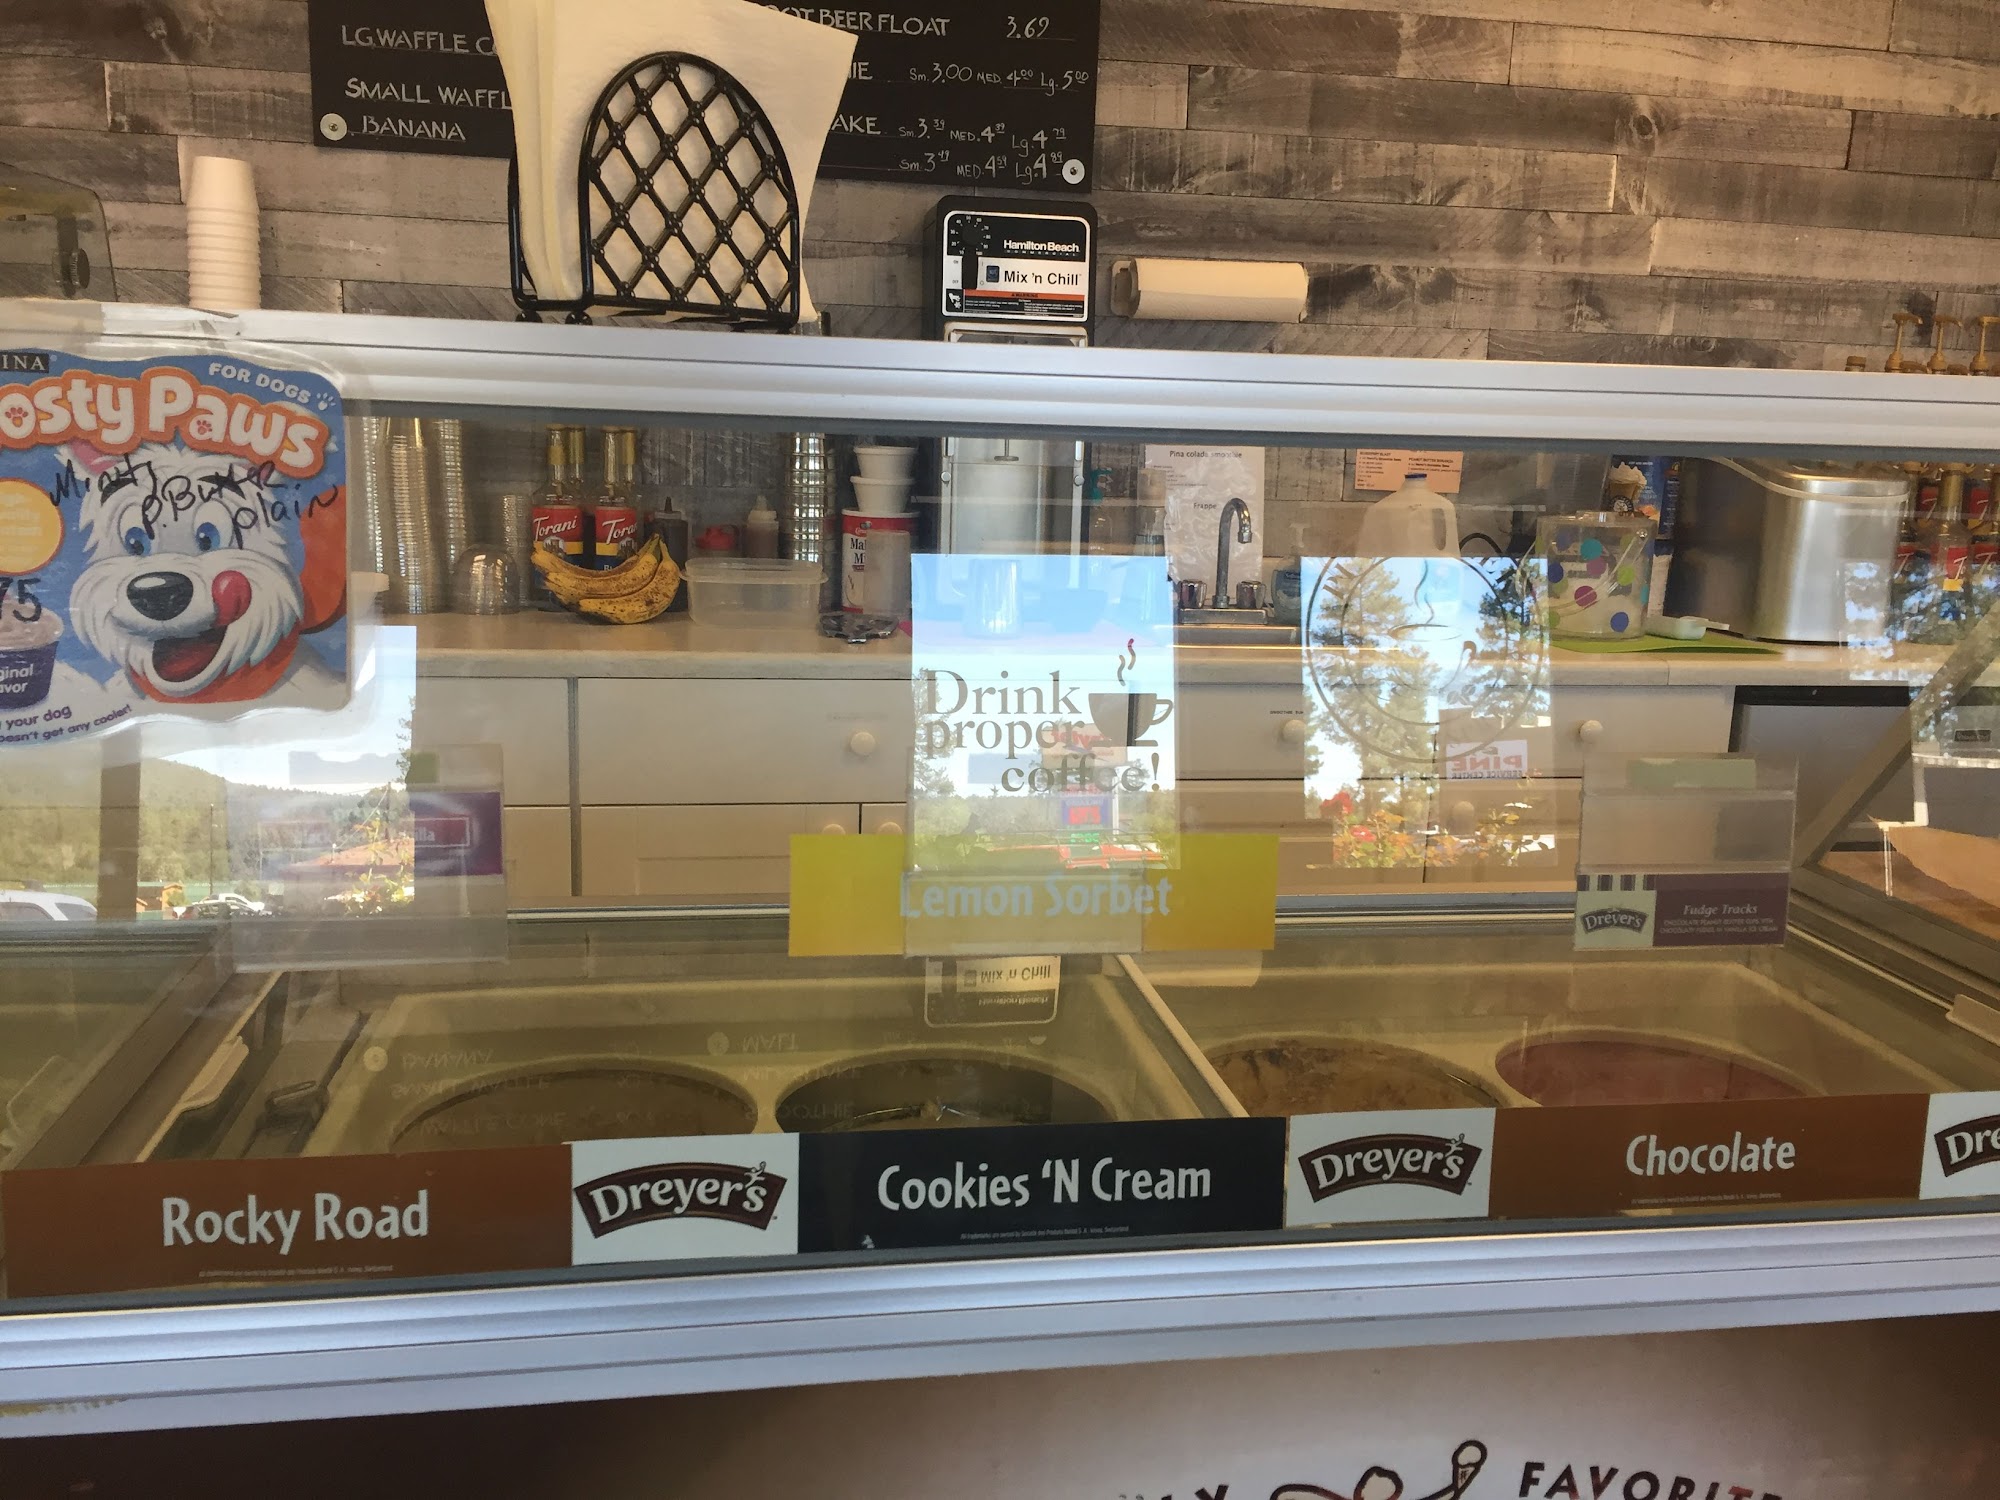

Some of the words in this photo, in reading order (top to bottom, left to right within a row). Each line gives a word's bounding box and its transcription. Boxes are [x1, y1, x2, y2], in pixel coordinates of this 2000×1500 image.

[819, 9, 874, 30] BEER
[878, 14, 950, 36] FLOAT
[1006, 16, 1050, 39] 3.69
[849, 62, 873, 81] IE
[345, 78, 430, 104] SMALL
[437, 86, 512, 110] WAFFL
[362, 115, 466, 141] BANANA
[830, 114, 881, 135] AKE
[1003, 239, 1047, 250] Hamilton
[1047, 242, 1080, 253] Beach
[1004, 271, 1028, 283] Mix
[1031, 273, 1043, 284] 'n
[1047, 273, 1079, 286] Chill
[2, 355, 46, 370] INA
[208, 361, 251, 384] FOR
[256, 373, 311, 405] DOGS
[0, 378, 135, 444] osty
[148, 375, 320, 469] Paws
[1169, 450, 1184, 458] Pina
[533, 514, 578, 541] Torani
[850, 537, 867, 550] Mal
[0, 664, 34, 682] ginal
[0, 682, 28, 694] avor
[923, 668, 1083, 715] Drink
[0, 730, 39, 743] oesn't
[43, 725, 64, 741] get
[67, 721, 90, 734] any
[93, 704, 132, 726] cooler!
[6, 716, 39, 731] your
[43, 705, 73, 723] dog
[924, 716, 1087, 760] proper
[1000, 751, 1161, 792] coffee!
[899, 874, 1034, 918] Lemon
[1045, 871, 1174, 917] Sorbet
[1683, 903, 1720, 916] Fudge
[1722, 903, 1758, 915] Tracks
[1584, 909, 1643, 930] Dreyer's
[1625, 1130, 1797, 1178] Chocolate
[1945, 1127, 2000, 1165] Dre
[1310, 1140, 1465, 1191] Dreyer's
[877, 1160, 1031, 1212] Cookies
[1092, 1154, 1212, 1202] Cream
[590, 1173, 768, 1225] Dreyer's
[163, 1194, 301, 1256] Rocky
[315, 1189, 430, 1244] Road
